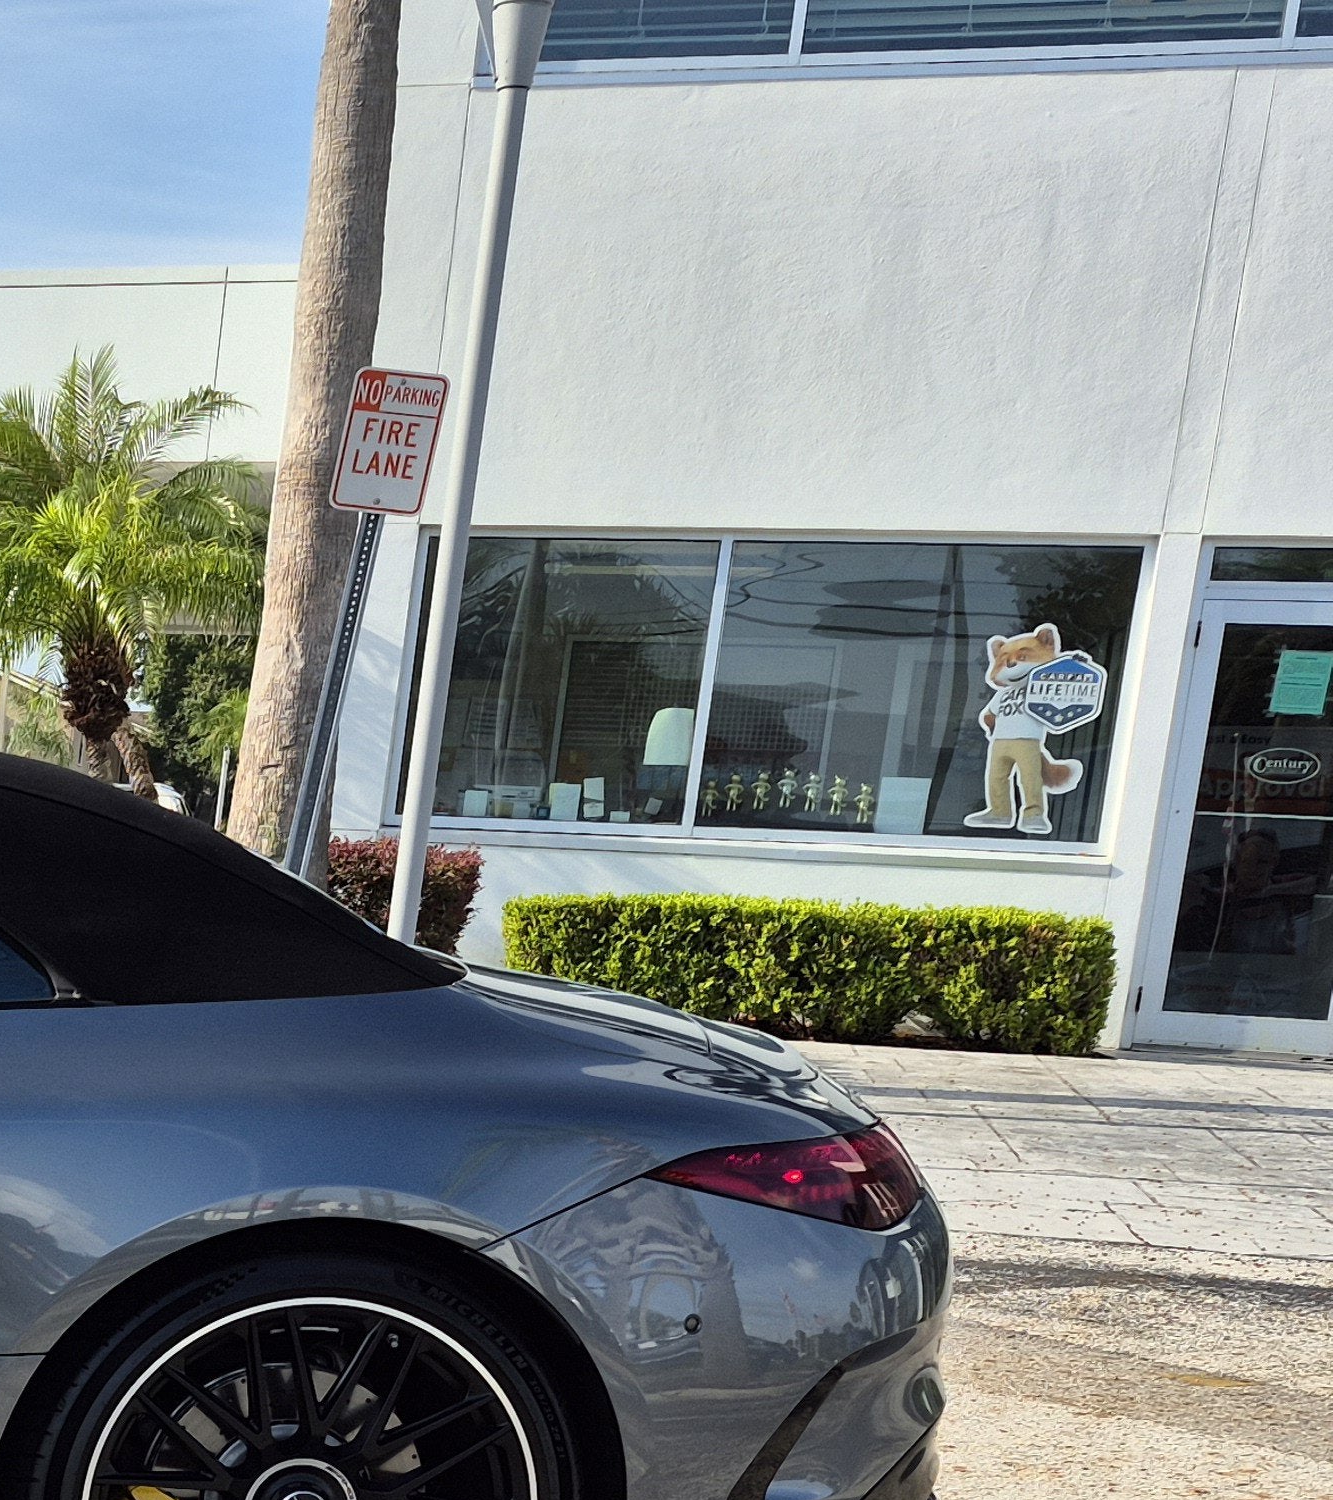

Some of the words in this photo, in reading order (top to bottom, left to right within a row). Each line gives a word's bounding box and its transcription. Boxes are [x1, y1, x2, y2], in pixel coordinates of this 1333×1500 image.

[355, 377, 383, 405] NO
[383, 384, 441, 408] PARKING
[362, 416, 421, 448] FIRE
[351, 448, 418, 480] LANE
[1029, 683, 1098, 698] LIFETIME
[997, 701, 1025, 717] FOX
[1252, 756, 1316, 774] Century
